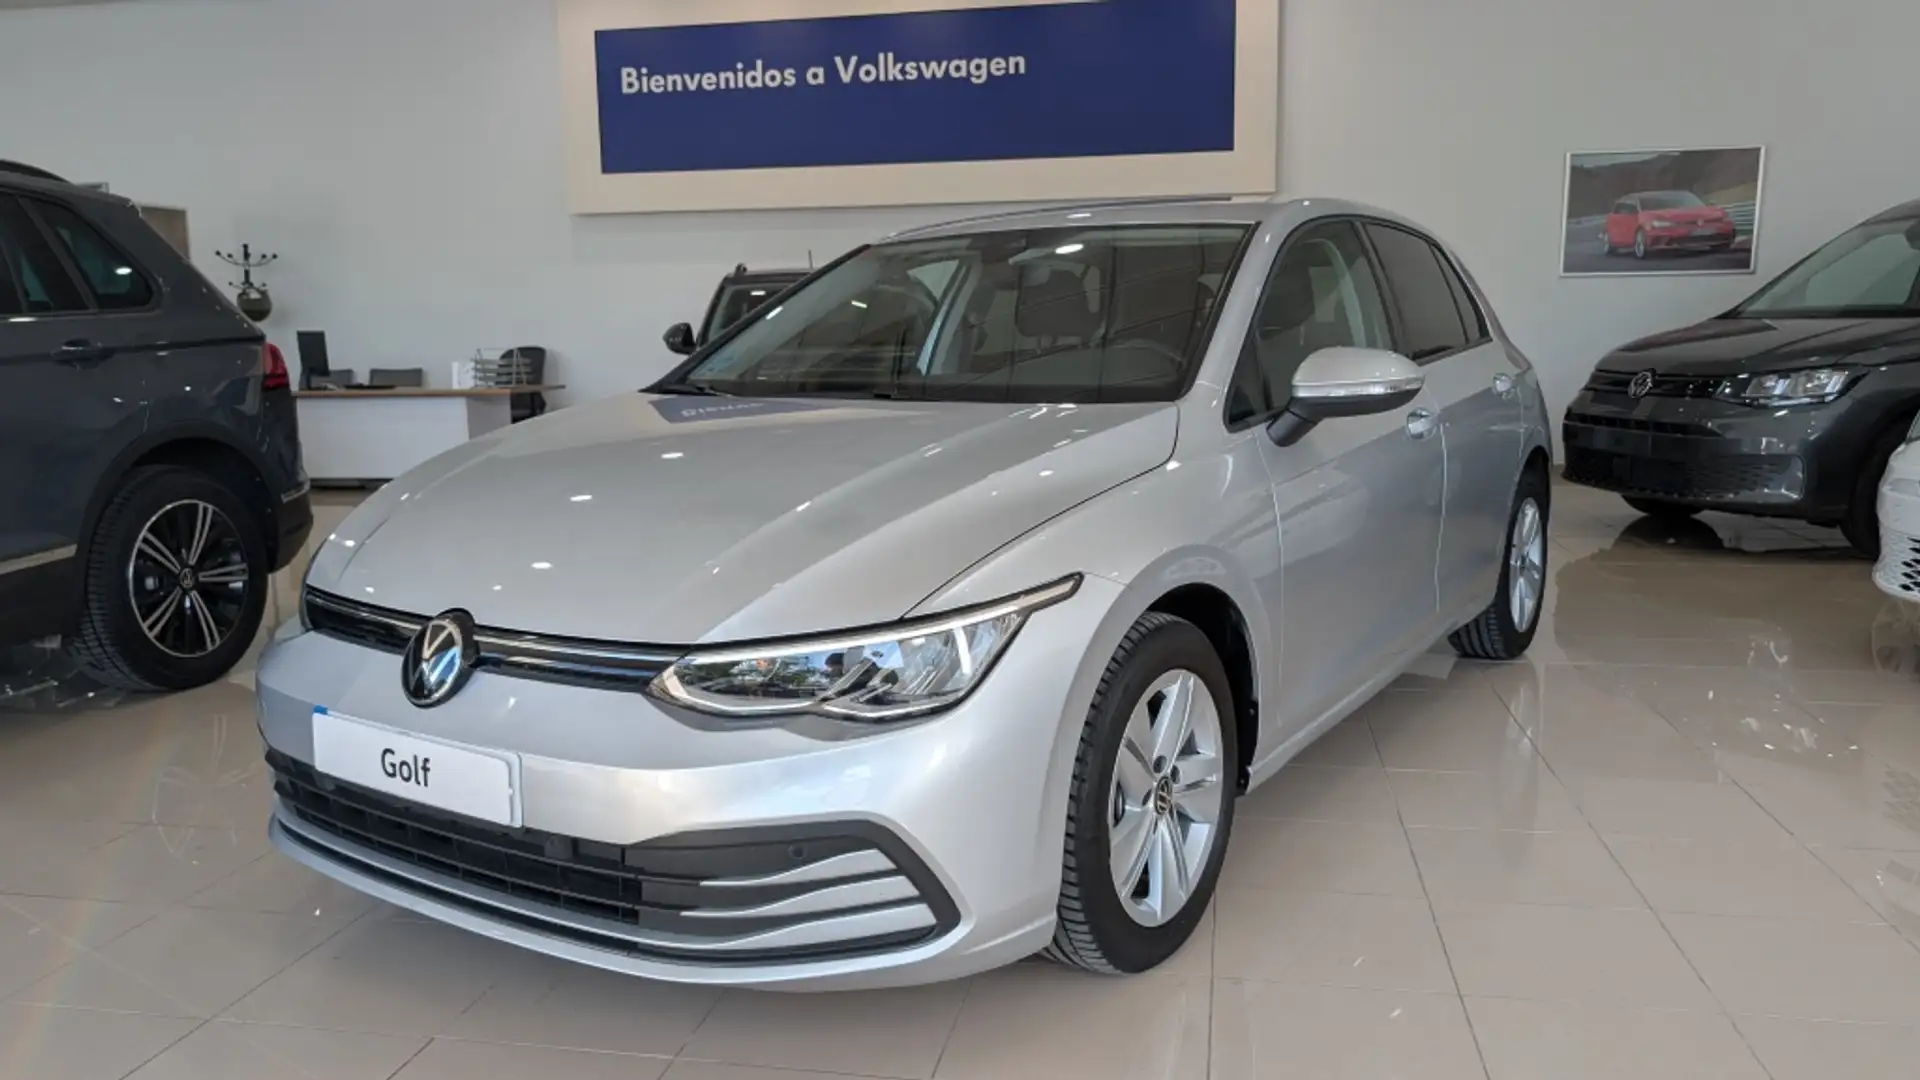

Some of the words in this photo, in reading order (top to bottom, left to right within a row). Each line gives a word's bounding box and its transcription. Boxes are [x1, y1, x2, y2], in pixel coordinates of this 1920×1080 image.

[620, 60, 796, 93] Bienvenidos
[806, 67, 824, 85] a
[834, 52, 1025, 84] Volkswagen
[381, 748, 431, 787] Golf
